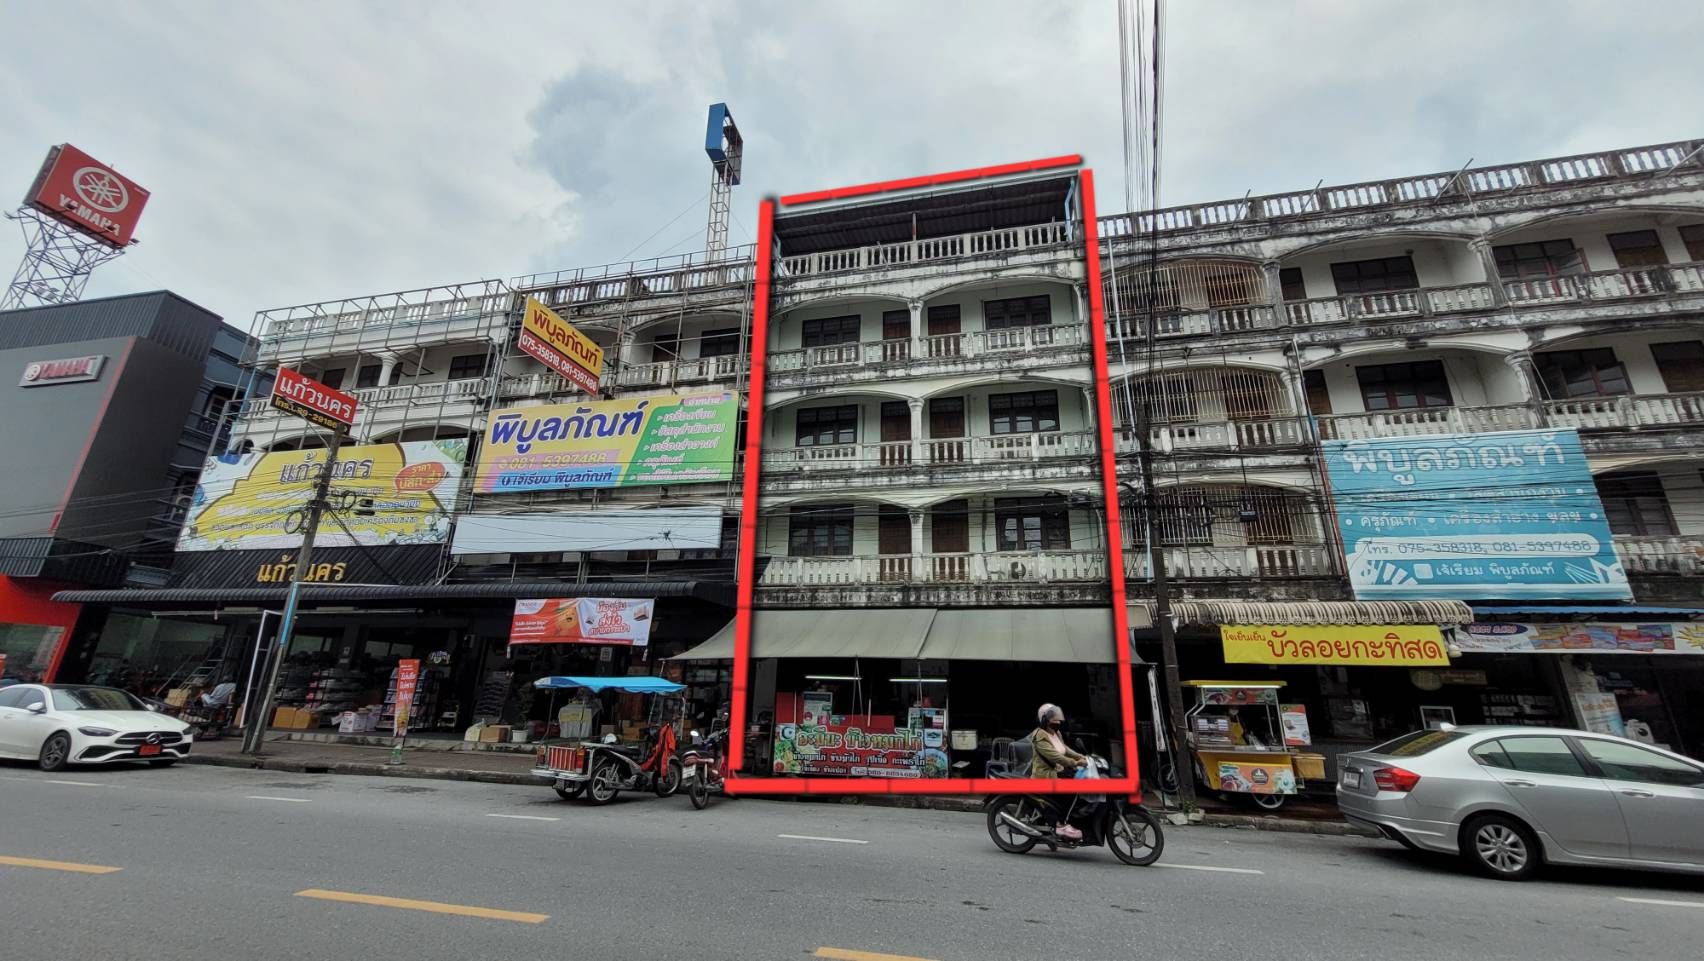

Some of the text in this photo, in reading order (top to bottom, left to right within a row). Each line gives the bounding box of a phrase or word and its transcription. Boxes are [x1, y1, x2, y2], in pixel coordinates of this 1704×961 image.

[59, 193, 121, 237] YAMAHA
[531, 308, 600, 367] พิบูลภัณฑ์
[280, 377, 352, 419] แก้วนคร
[490, 400, 649, 455] พิบูลภัณฑ์
[554, 467, 614, 488] พิบูลภัณฑ์
[1489, 561, 1555, 580] พิบูลภัณฑ์
[1267, 630, 1443, 660] บัวลอยกะทิสด
